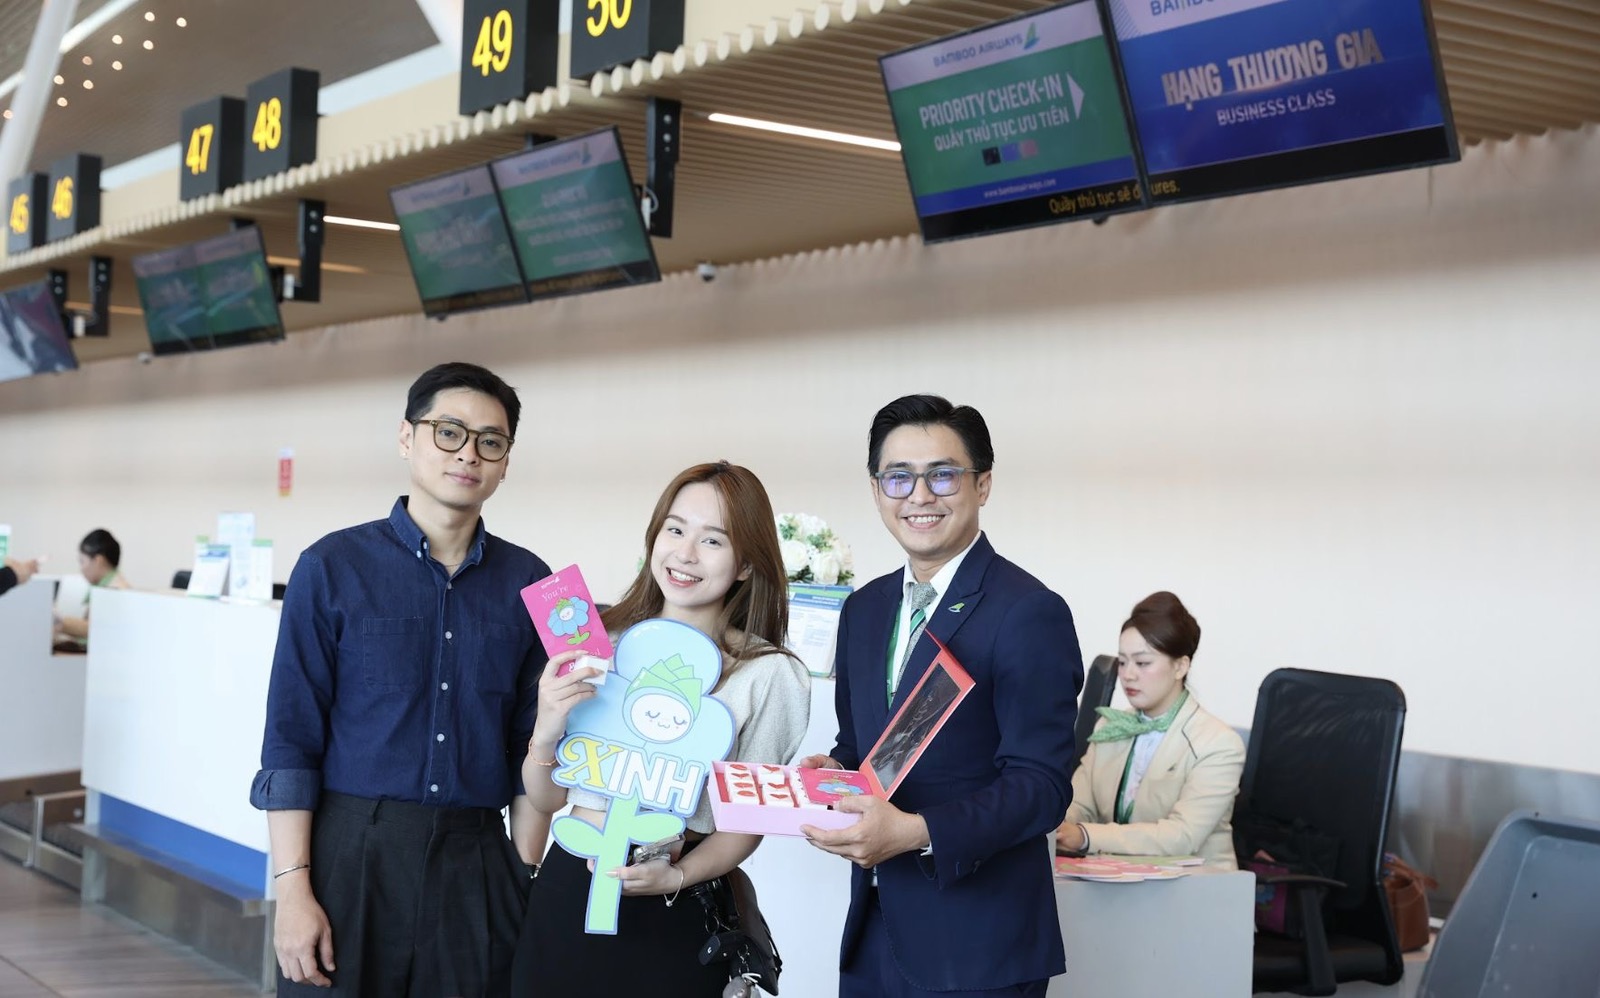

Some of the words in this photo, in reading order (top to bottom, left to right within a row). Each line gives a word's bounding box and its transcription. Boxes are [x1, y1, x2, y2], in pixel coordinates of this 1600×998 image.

[471, 9, 513, 77] 49
[933, 46, 977, 68] BAMBOO
[979, 33, 1023, 57] AIRWAYS
[1161, 64, 1223, 111] HẠNG
[1228, 38, 1328, 92] THƯƠNG
[1336, 27, 1385, 70] GIA
[252, 97, 282, 152] 48
[919, 90, 987, 129] PRIORITY
[989, 74, 1064, 114] CHECK-IN
[1216, 97, 1286, 126] BUSINESS
[1287, 88, 1337, 114] CLASS
[185, 123, 214, 175] 47
[967, 119, 991, 144] THỦ
[992, 119, 1017, 141] TỤC
[51, 176, 74, 219] 46
[1097, 190, 1116, 207] tục
[561, 737, 699, 810] XINH
